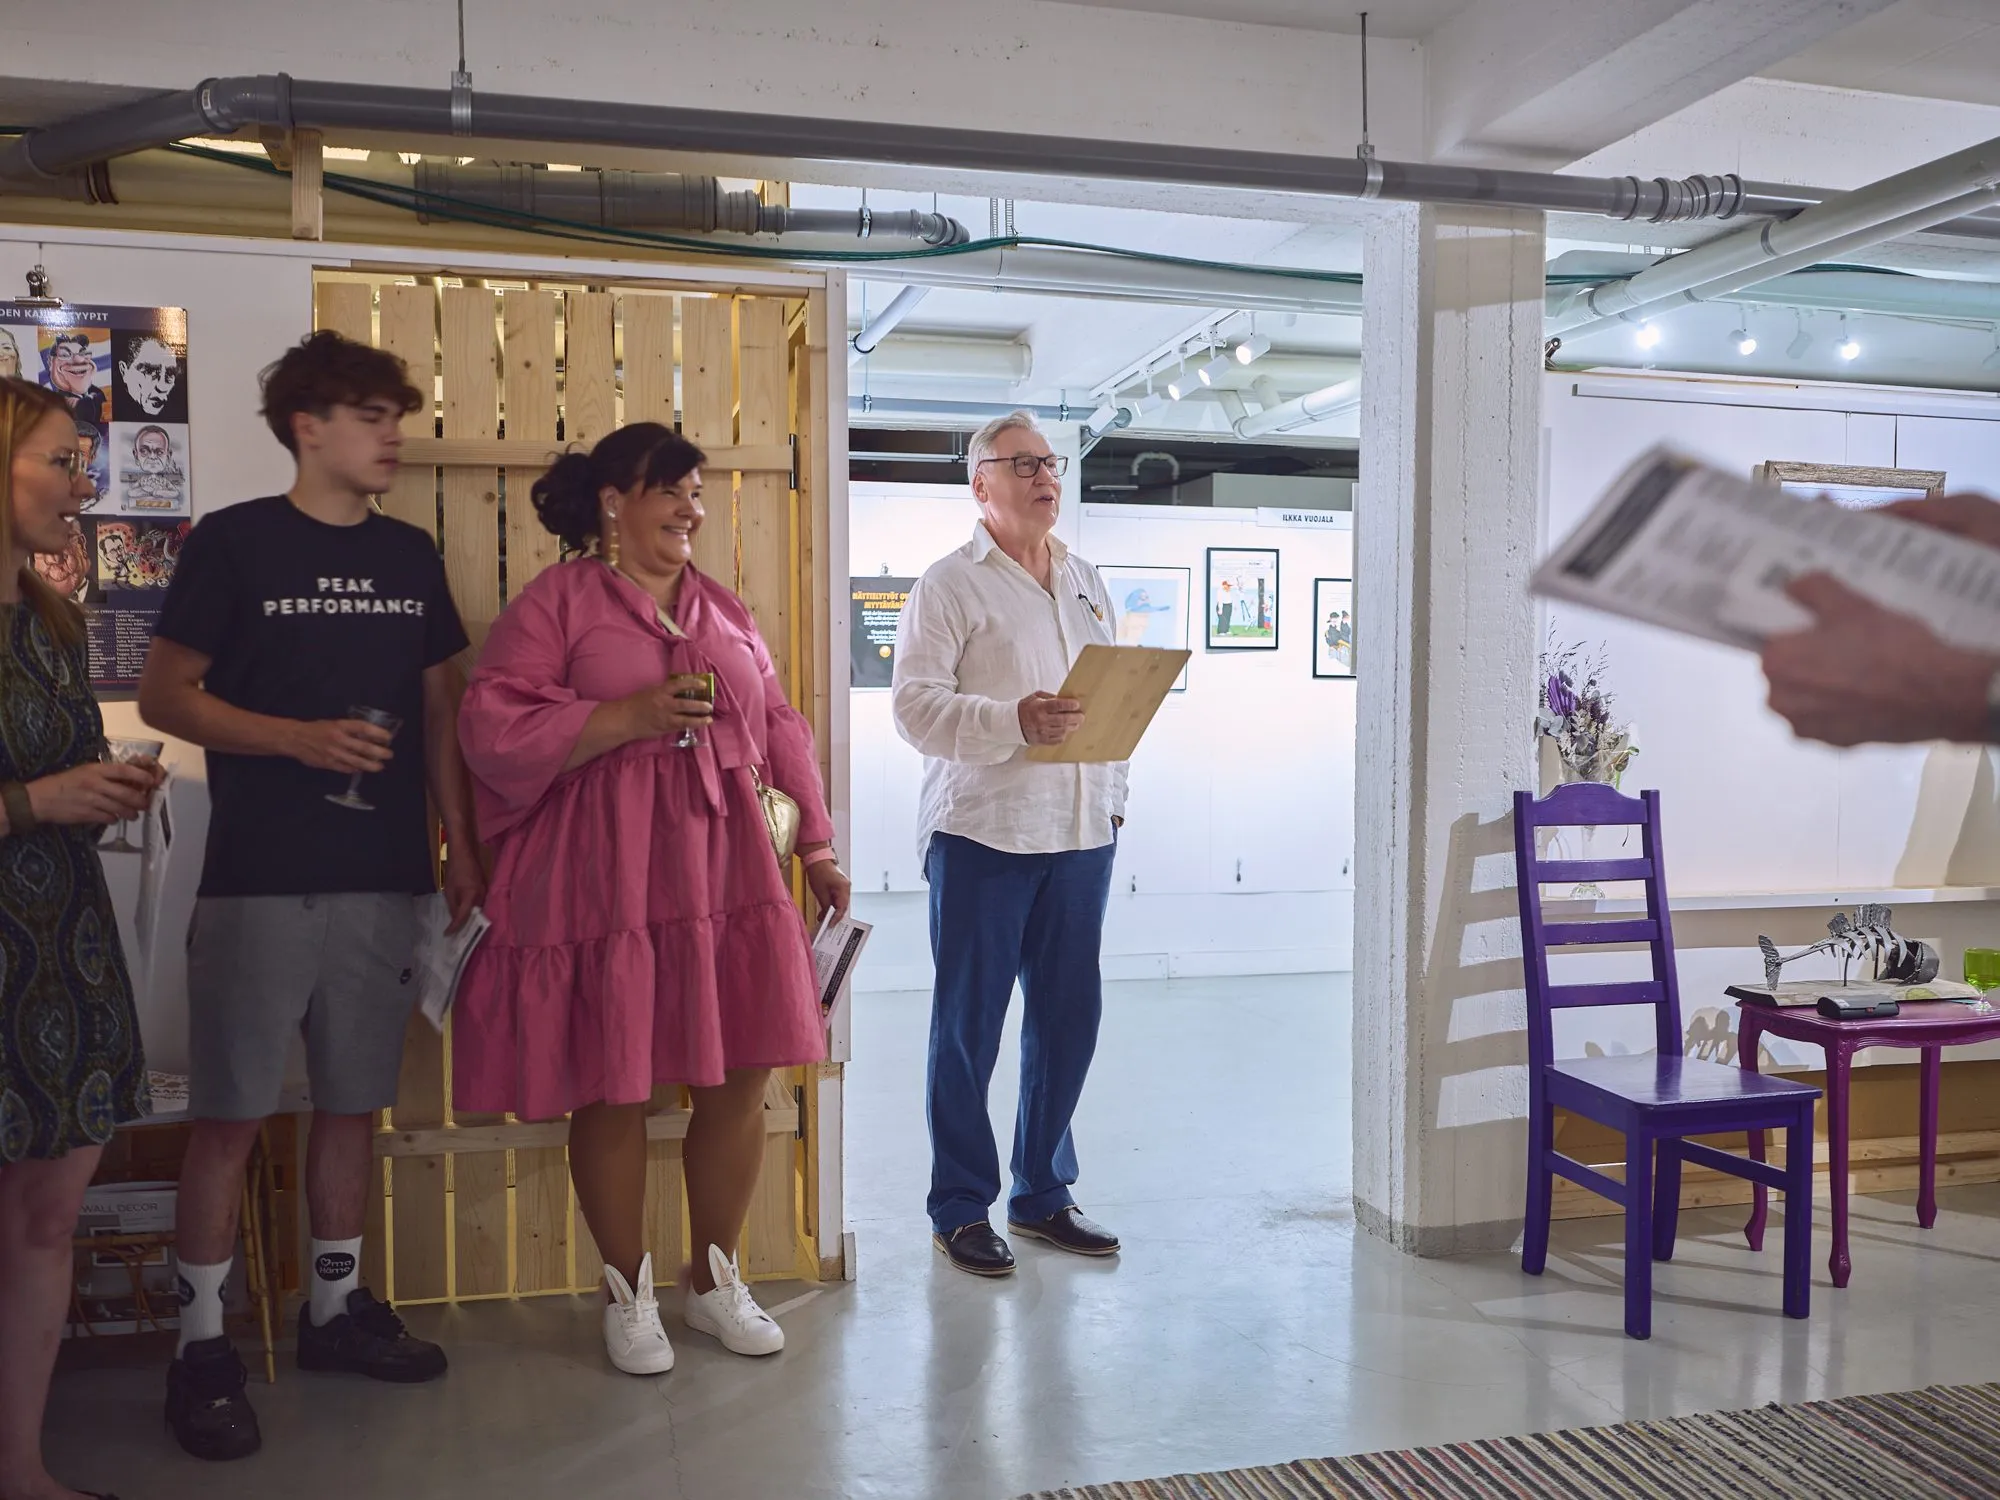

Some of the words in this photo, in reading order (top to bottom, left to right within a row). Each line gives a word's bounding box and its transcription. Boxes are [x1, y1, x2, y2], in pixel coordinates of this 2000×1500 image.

[1282, 514, 1302, 522] ILKKA
[1304, 515, 1334, 523] VUOJALA
[317, 578, 376, 593] PEAK
[263, 598, 425, 616] PERFORMANCE
[80, 1205, 115, 1213] WALL
[116, 1202, 158, 1212] DECOR
